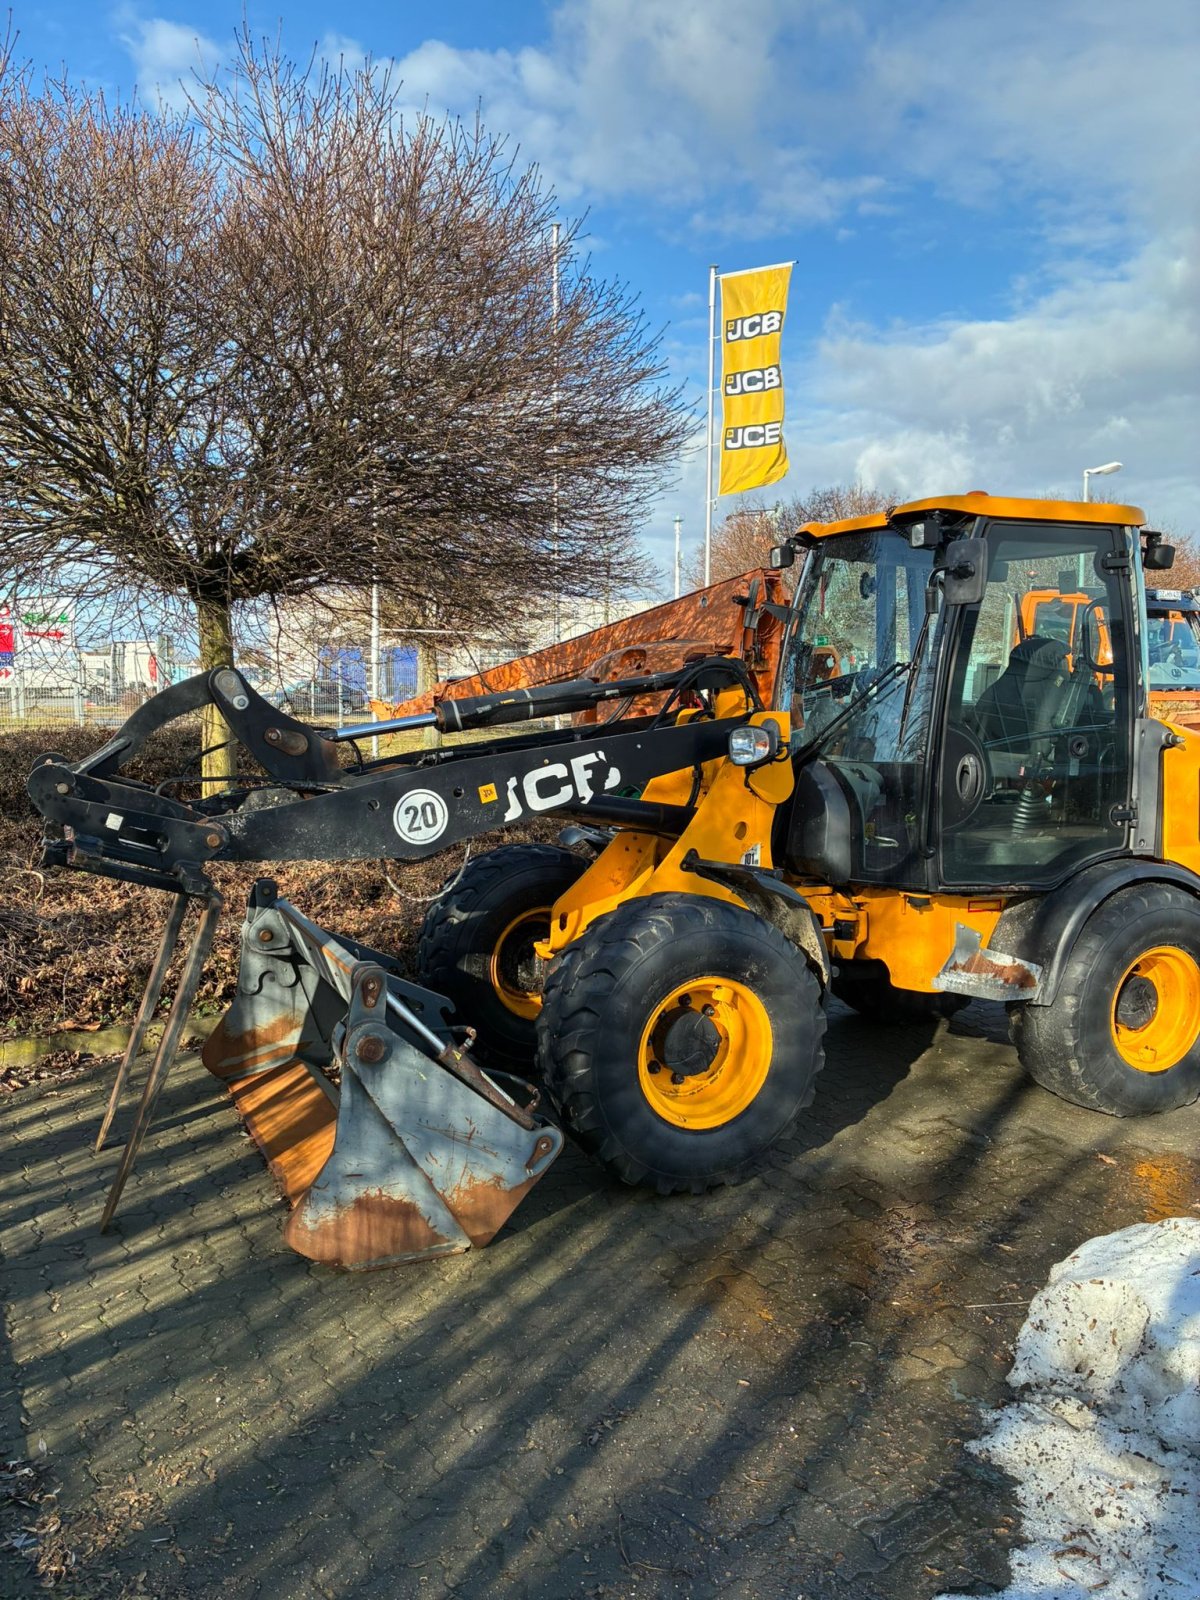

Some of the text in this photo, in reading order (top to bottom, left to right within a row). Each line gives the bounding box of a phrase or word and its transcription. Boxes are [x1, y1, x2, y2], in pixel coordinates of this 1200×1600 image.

[727, 311, 781, 340] JCB
[726, 367, 780, 394] JCB
[404, 801, 438, 833] 20
